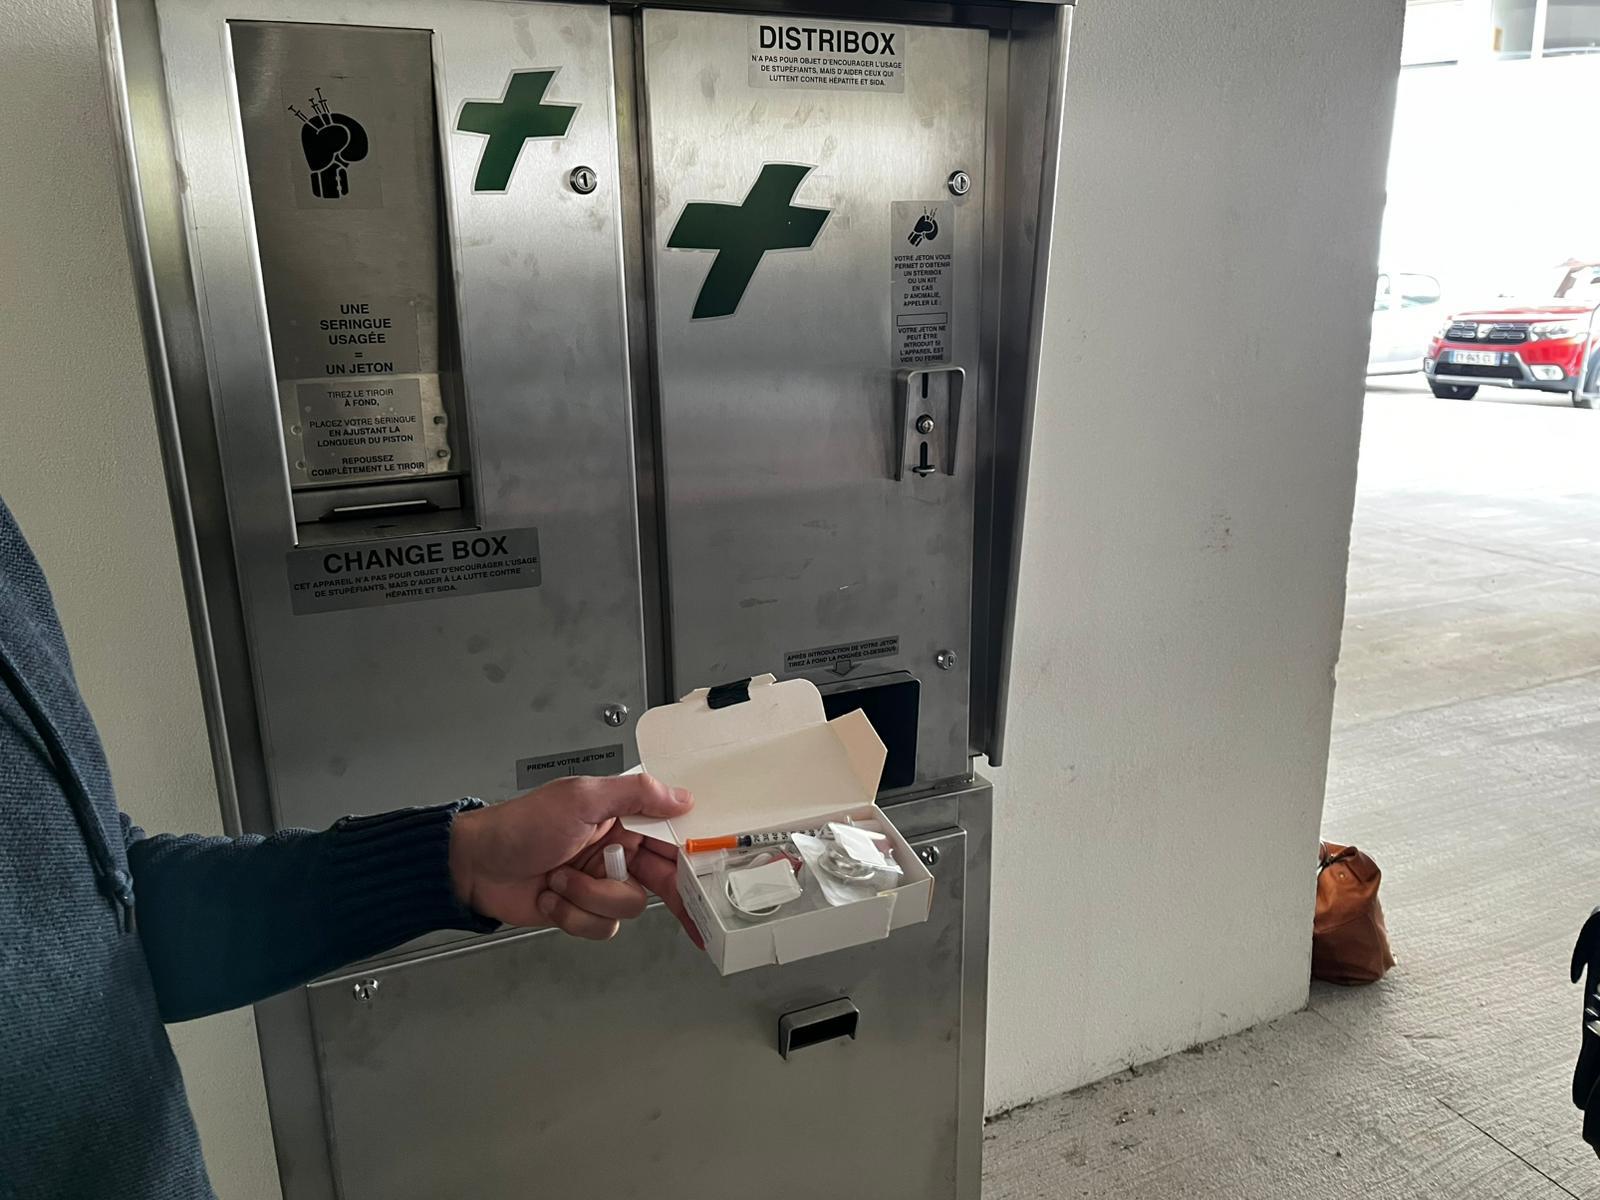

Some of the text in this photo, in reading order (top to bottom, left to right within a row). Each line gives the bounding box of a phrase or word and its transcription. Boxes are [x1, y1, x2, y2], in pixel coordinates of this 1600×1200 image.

[760, 25, 895, 55] DISTRIBOX
[822, 58, 874, 68] D'ENCOURAGER
[875, 60, 902, 69] L'USAGE
[772, 65, 818, 74] STUPÉFIANTS,
[829, 76, 858, 85] HÉPATITE
[340, 304, 369, 314] UNE
[320, 318, 392, 330] SERINGUE
[329, 332, 386, 345] USAGÉE
[326, 362, 392, 374] UN JETON
[366, 388, 394, 397] TIROIR
[344, 398, 380, 407] À FOND,
[310, 416, 416, 428] PLACEZ VOTRE SERINGUE
[330, 429, 341, 437] EN
[343, 427, 386, 436] AJUSTANT
[318, 437, 366, 448] LONGUEUR
[383, 435, 414, 443] PISTON
[342, 454, 394, 465] REPOUSSEZ
[384, 463, 396, 471] LE
[398, 462, 424, 470] TIROIR
[323, 535, 508, 574] CHANGE BOX
[294, 582, 310, 591] CET
[313, 578, 353, 588] APPAREIL
[389, 572, 411, 580] POUR
[414, 568, 440, 577] OBJET
[442, 561, 503, 574] D'ENCOURAGER
[504, 557, 537, 566] L'USAGE
[388, 580, 408, 589] MAIS
[410, 577, 442, 586] D'AIDER
[463, 572, 488, 580] LUTTE
[490, 568, 521, 577] CONTRE
[386, 588, 423, 599] HÉPATITE
[808, 647, 850, 658] INTRODUCTION
[837, 652, 862, 661] POIGNÉE
[527, 761, 555, 771] PRENEZ
[556, 758, 580, 766] VOTRE
[582, 754, 604, 762] JETON
